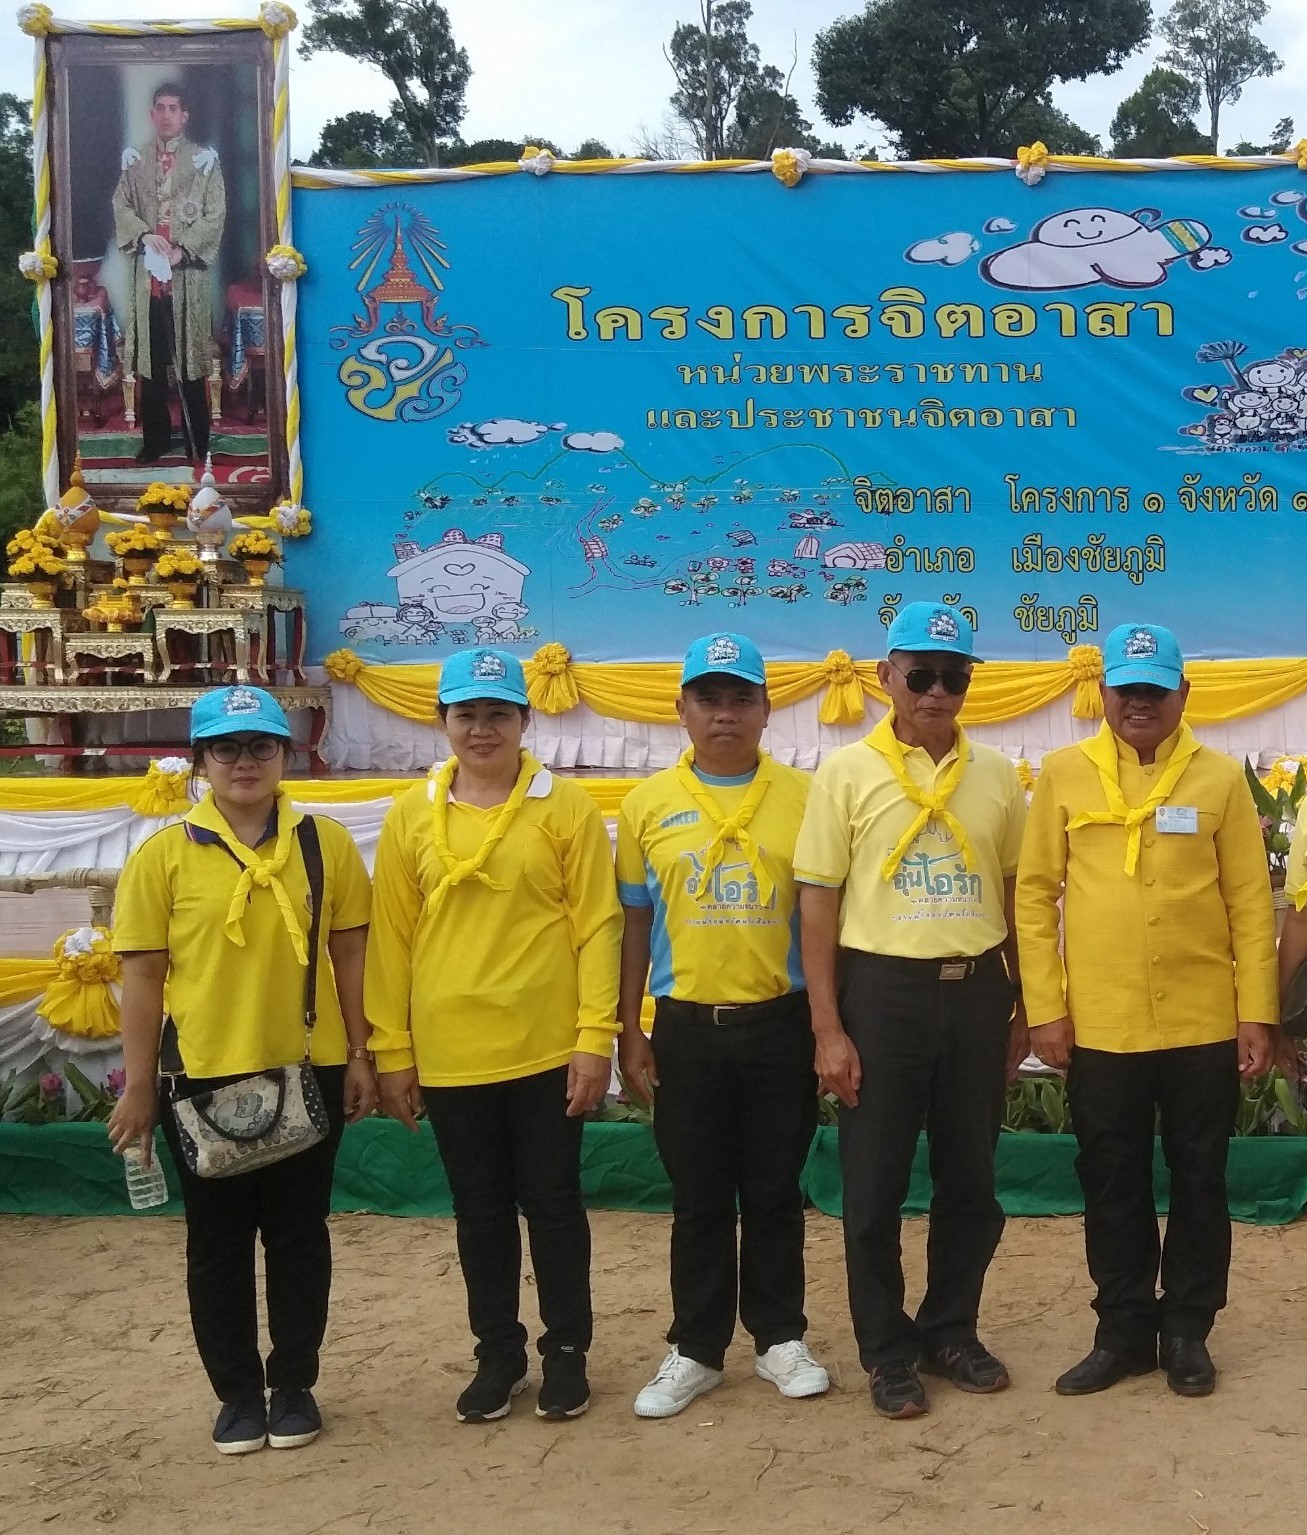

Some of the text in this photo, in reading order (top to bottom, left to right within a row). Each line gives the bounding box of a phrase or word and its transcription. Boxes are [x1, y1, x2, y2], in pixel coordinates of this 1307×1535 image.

[552, 284, 1176, 342] โครงการจิตอาสา
[678, 353, 1044, 386] หน่วยพระราชทาน
[646, 396, 1078, 430] และประชาชนจิตอาสา
[853, 475, 973, 515] จิตอาสา
[1005, 475, 1130, 515] โครงการ
[1141, 492, 1166, 513] ๑
[1177, 473, 1279, 514] จังหวัด
[883, 533, 1166, 585] อำเภอ เมืองชัยภูมิ
[1014, 593, 1100, 646] ชัยภูมิ
